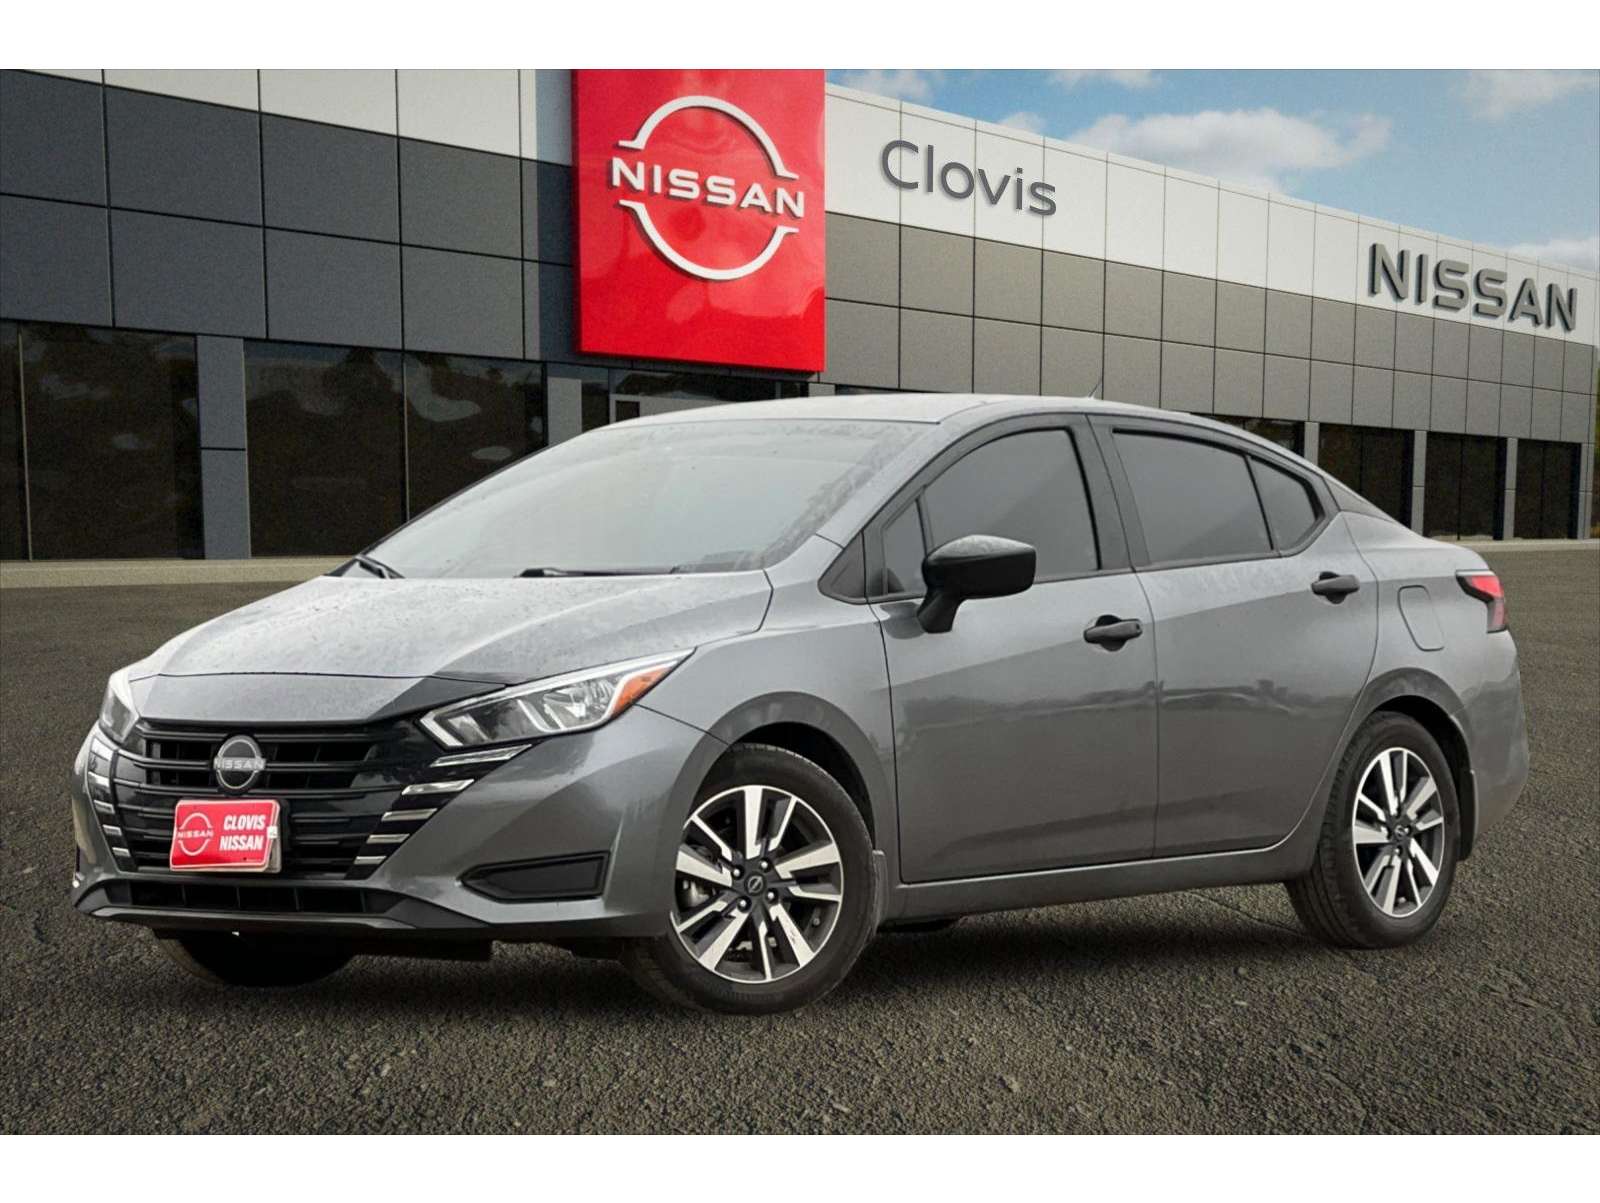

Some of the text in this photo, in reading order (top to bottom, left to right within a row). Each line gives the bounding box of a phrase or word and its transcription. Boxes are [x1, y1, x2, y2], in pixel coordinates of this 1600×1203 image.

[882, 139, 1057, 216] Clovis
[611, 156, 805, 218] NISSAN
[1368, 243, 1578, 332] NISSAN
[213, 757, 266, 771] NISSAN
[223, 814, 267, 831] CLOVIS
[177, 830, 214, 839] NISSAN
[219, 835, 265, 851] NISSAN
